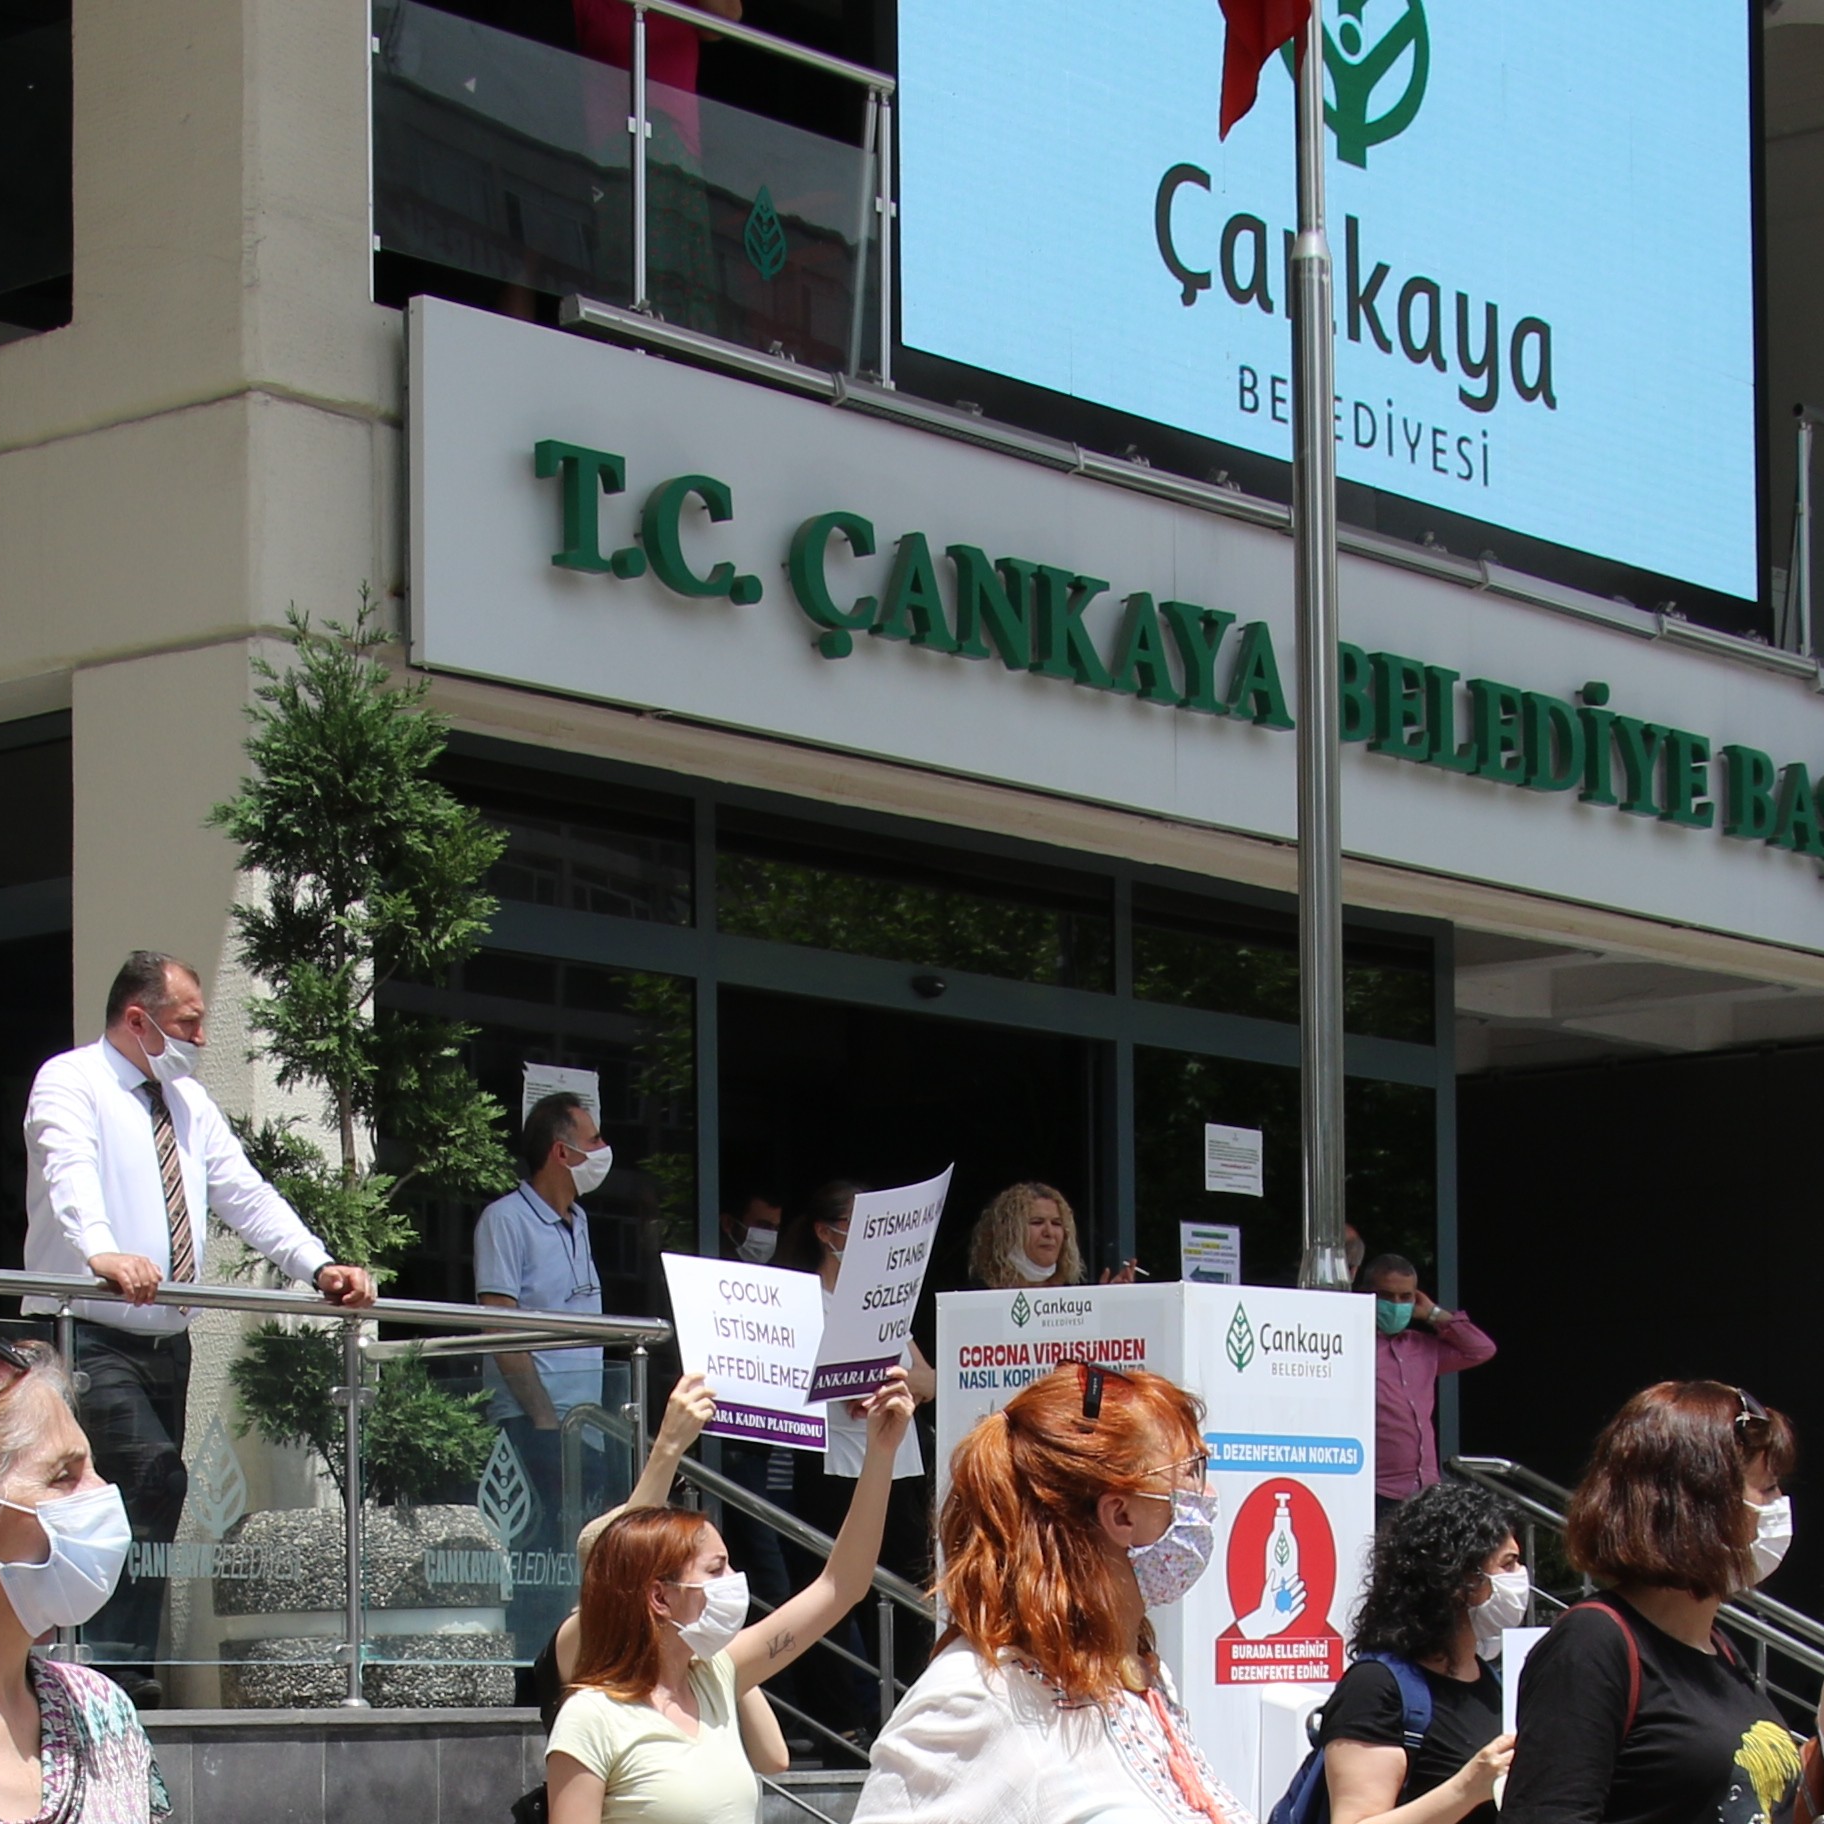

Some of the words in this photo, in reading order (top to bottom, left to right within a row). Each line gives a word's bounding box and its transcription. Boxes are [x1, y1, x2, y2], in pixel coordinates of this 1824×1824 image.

[1239, 364, 1491, 487] BEDİYESİ
[534, 439, 763, 605] T.C.
[788, 510, 1295, 732] ÇANKAYA
[1338, 641, 1714, 830] BELEDİYE
[719, 1279, 782, 1308] ÇOCUK
[1033, 1297, 1093, 1318] Çankaya
[713, 1310, 795, 1349] İSTİSMARI
[1041, 1317, 1085, 1328] BELEDİYESİ
[959, 1343, 1030, 1369] CORONA
[1032, 1337, 1146, 1366] VİRÜSÜNDEN
[1259, 1322, 1344, 1361] Çankaya
[707, 1353, 810, 1391] AFFEDİLEMEZ
[815, 1369, 865, 1389] ANKARA
[959, 1368, 999, 1389] NASIL
[1271, 1361, 1333, 1379] BELEDİYESİ
[735, 1412, 767, 1431] KADIN
[767, 1416, 824, 1438] PLATFORMU
[1223, 1443, 1307, 1463] DEZENFEKTAN
[1309, 1446, 1358, 1465] NOKTASI
[1231, 1643, 1274, 1660] BURADA
[1275, 1639, 1329, 1659] ELLERİNİZİ
[1230, 1665, 1295, 1681] DEZENFEKTE
[1296, 1660, 1330, 1680] EDİNİZ
